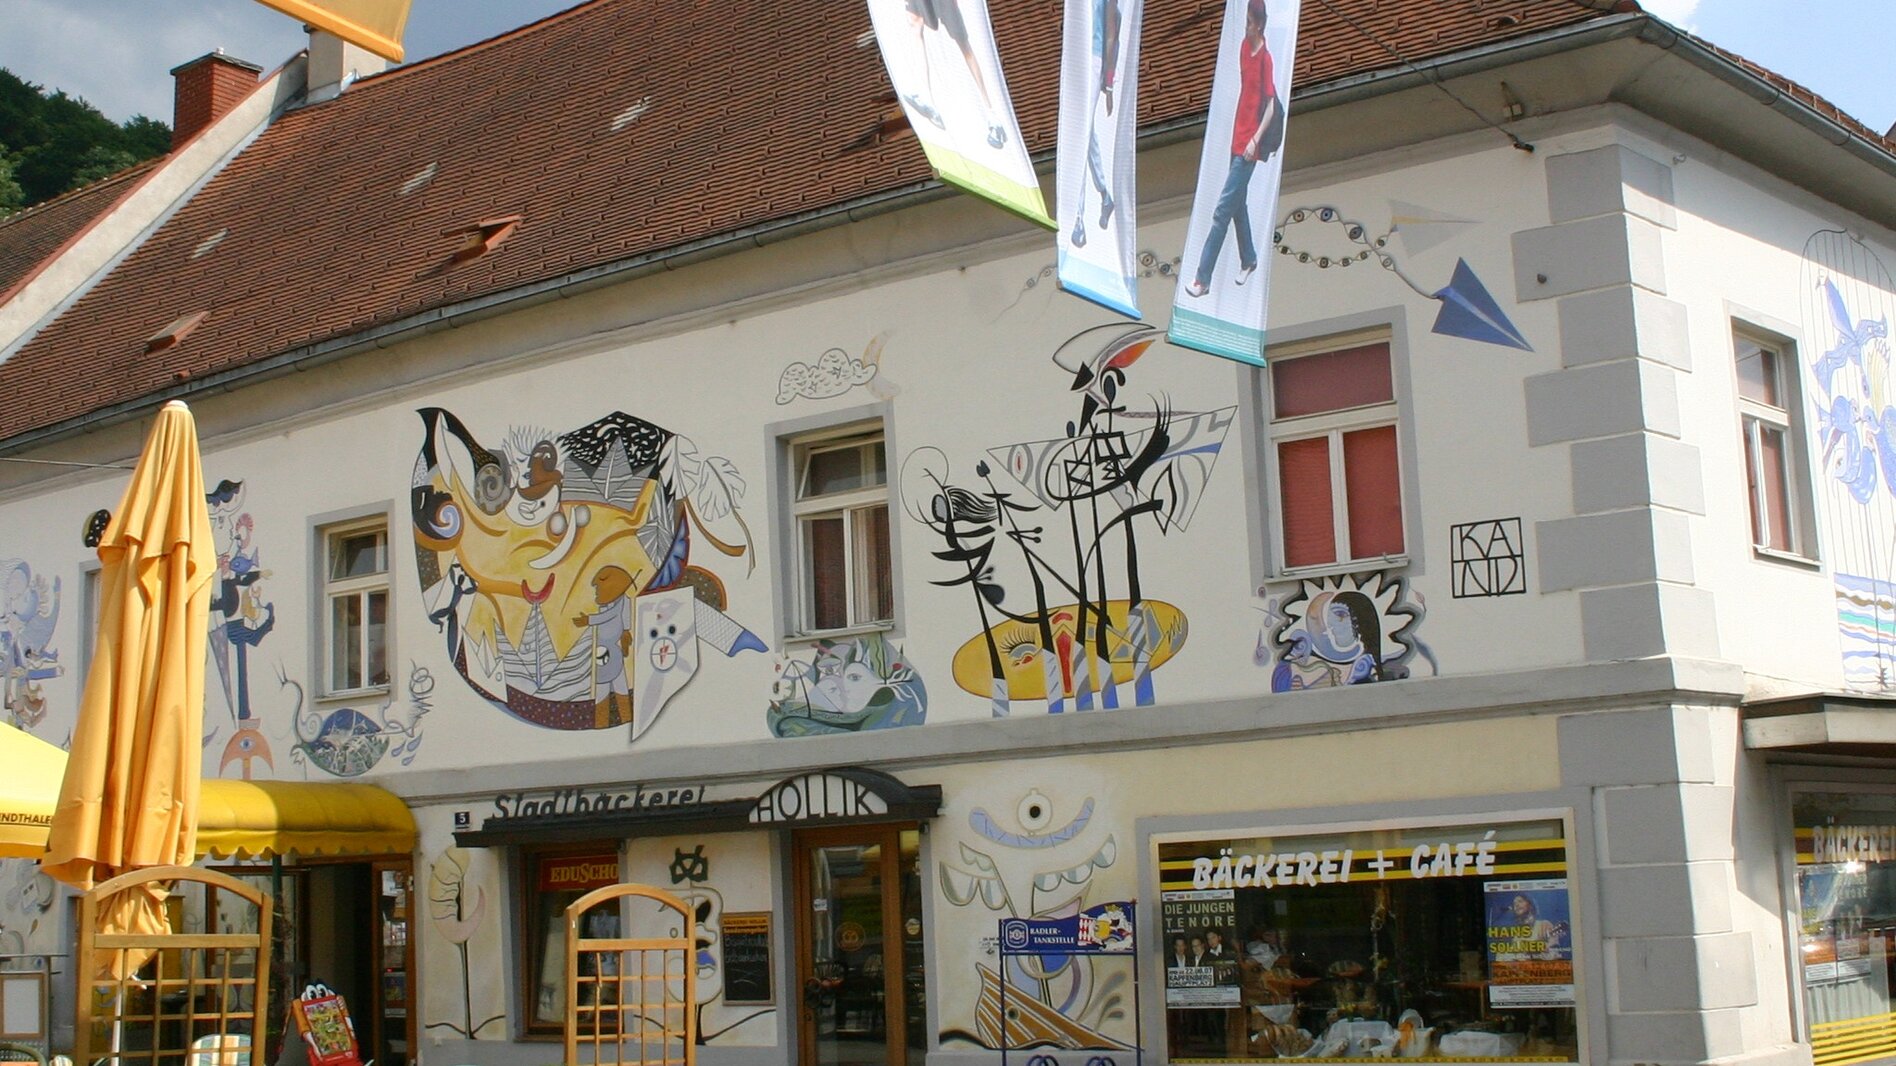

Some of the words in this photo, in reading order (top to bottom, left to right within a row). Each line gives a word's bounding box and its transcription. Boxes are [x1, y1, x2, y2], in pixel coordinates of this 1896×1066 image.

[756, 774, 876, 823] HOLLIK
[0, 812, 51, 824] NDTHALE
[459, 812, 466, 825] 5
[1192, 847, 1353, 889] BÄCKEREI
[1410, 830, 1497, 878] CAFÉ
[1164, 904, 1184, 915] DIE
[1186, 902, 1235, 914] JUNGEN
[1487, 925, 1533, 938] HANS
[1033, 936, 1075, 944] TANKSTELLE
